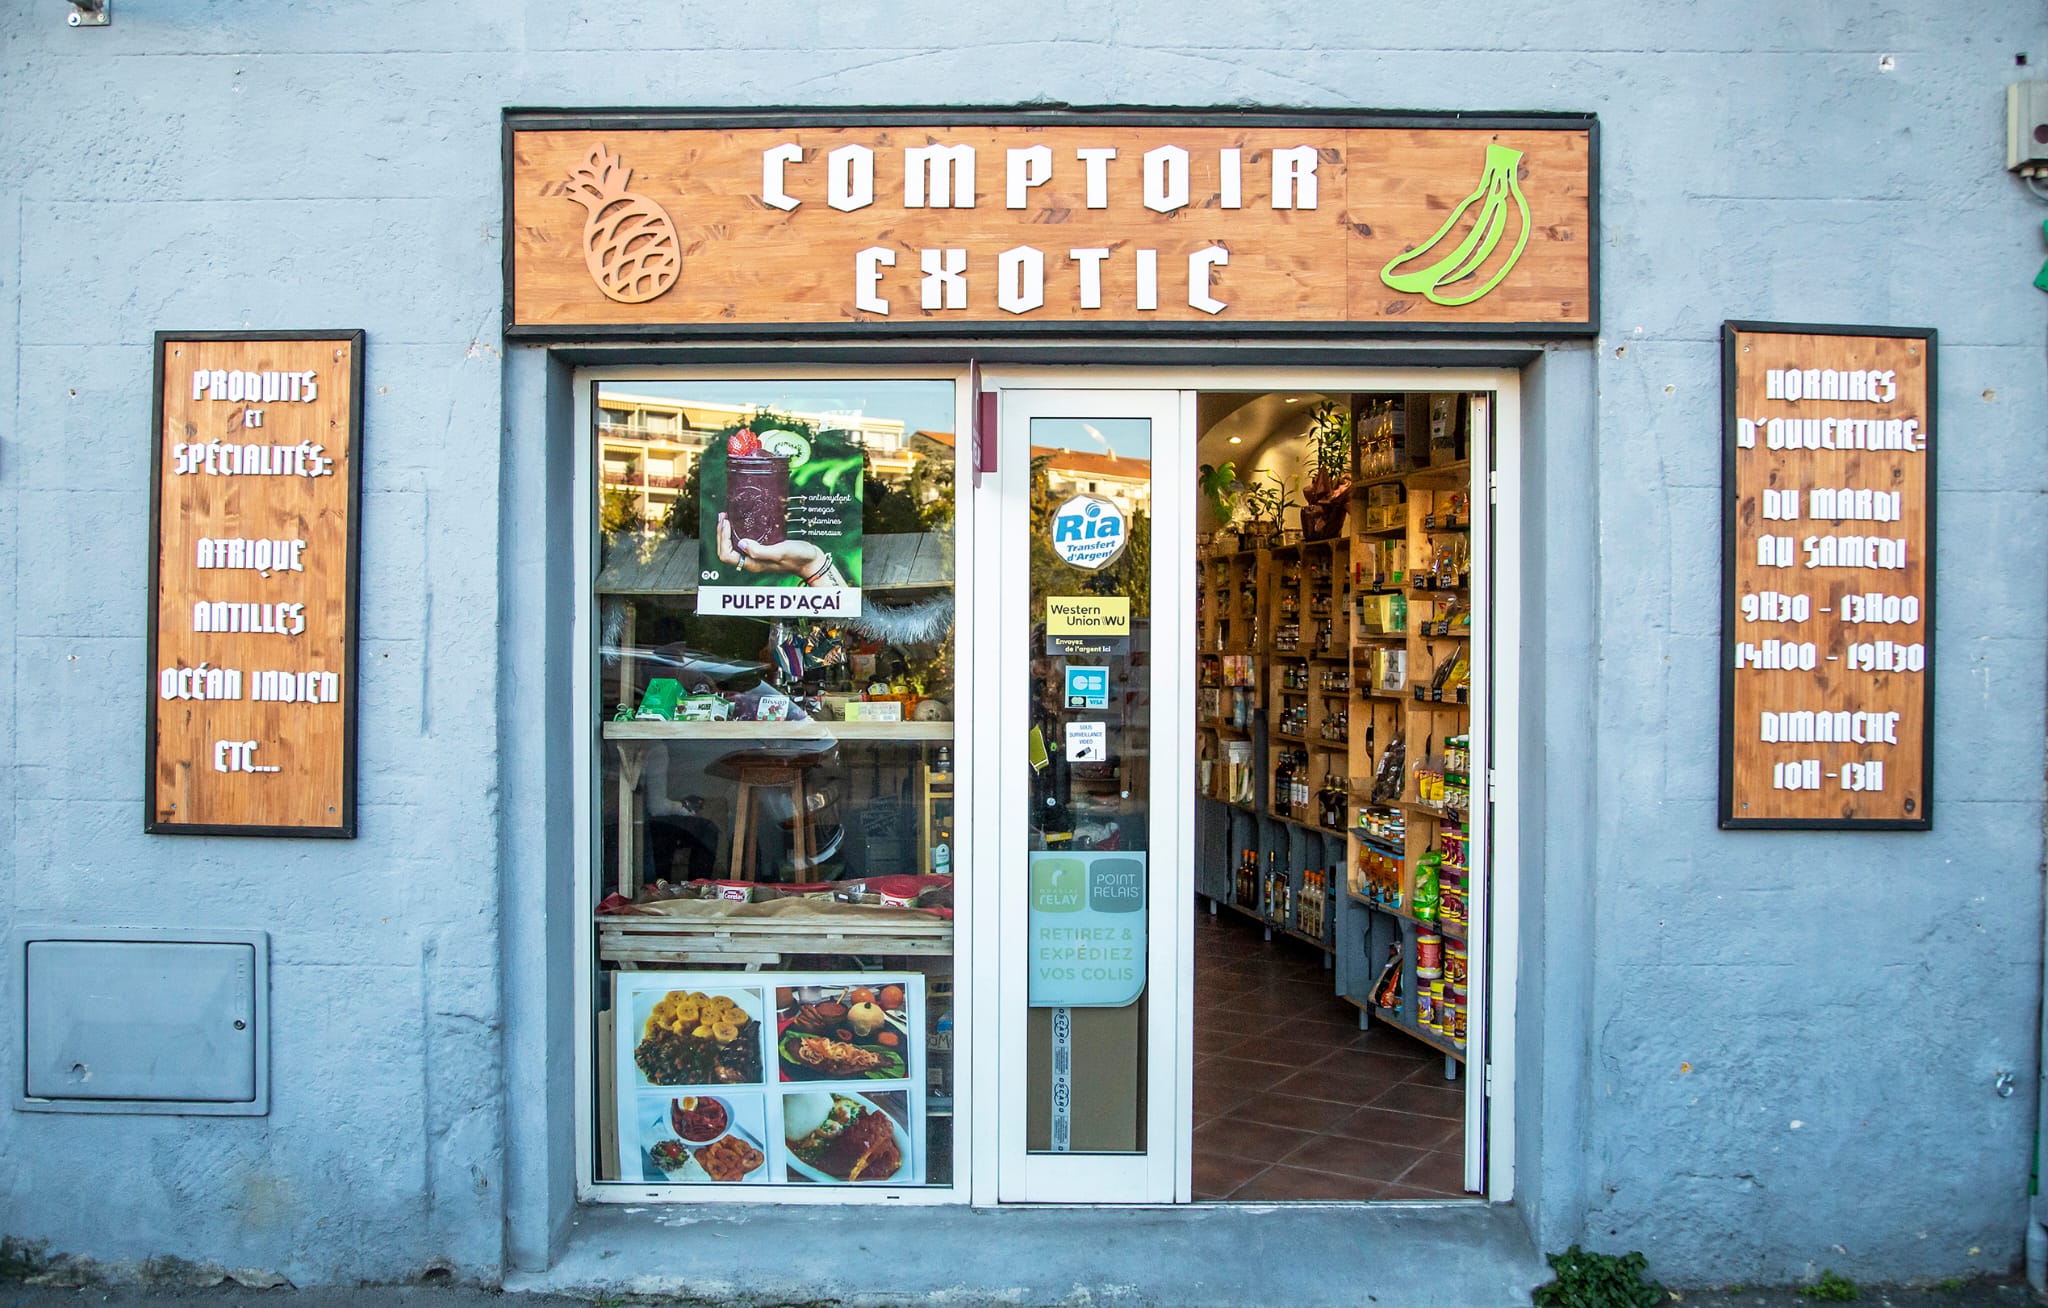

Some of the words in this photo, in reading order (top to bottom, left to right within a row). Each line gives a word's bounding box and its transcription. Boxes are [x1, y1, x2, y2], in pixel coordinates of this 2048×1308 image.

[762, 143, 1319, 212] COMPTOIR
[855, 245, 1230, 315] EXOTIC
[192, 368, 318, 403] PRODUITS
[1766, 368, 1897, 403] HORAIRES
[245, 409, 264, 428] ET
[1737, 416, 1926, 452] D'OUVERTURE:
[172, 437, 333, 477] SPÉCIALITÉS:
[1763, 488, 1799, 521] DU
[1810, 487, 1901, 522] MARDI
[1055, 502, 1121, 542] Ria
[196, 537, 307, 578] AFRIQUE
[1066, 540, 1116, 552] Transfert
[1757, 534, 1794, 568] AU
[1803, 535, 1906, 570] SAMEDI
[193, 600, 305, 635] ANTILLES
[722, 594, 775, 609] PULPE
[780, 590, 841, 614] D'AÇAÍ
[1050, 604, 1101, 615] Western
[1741, 591, 1811, 623] 9H30
[1841, 592, 1920, 624] 13H00
[1066, 615, 1101, 626] Union
[1735, 639, 1817, 671] 14H00
[1847, 640, 1925, 673] 19H30
[161, 661, 242, 701] OCÉAN
[251, 670, 339, 704] INDIEN
[1761, 710, 1900, 745] DIMANCHE
[1774, 759, 1821, 791] 10H
[1841, 761, 1884, 792] 13H
[1093, 886, 1140, 898] RELAIS
[1096, 873, 1137, 886] POINT
[1039, 927, 1116, 941] RETIREZ
[1121, 927, 1133, 941] &
[1039, 944, 1134, 961] EXPÉDIEZ
[1039, 967, 1076, 981] VOS
[1081, 967, 1134, 981] COLIS
